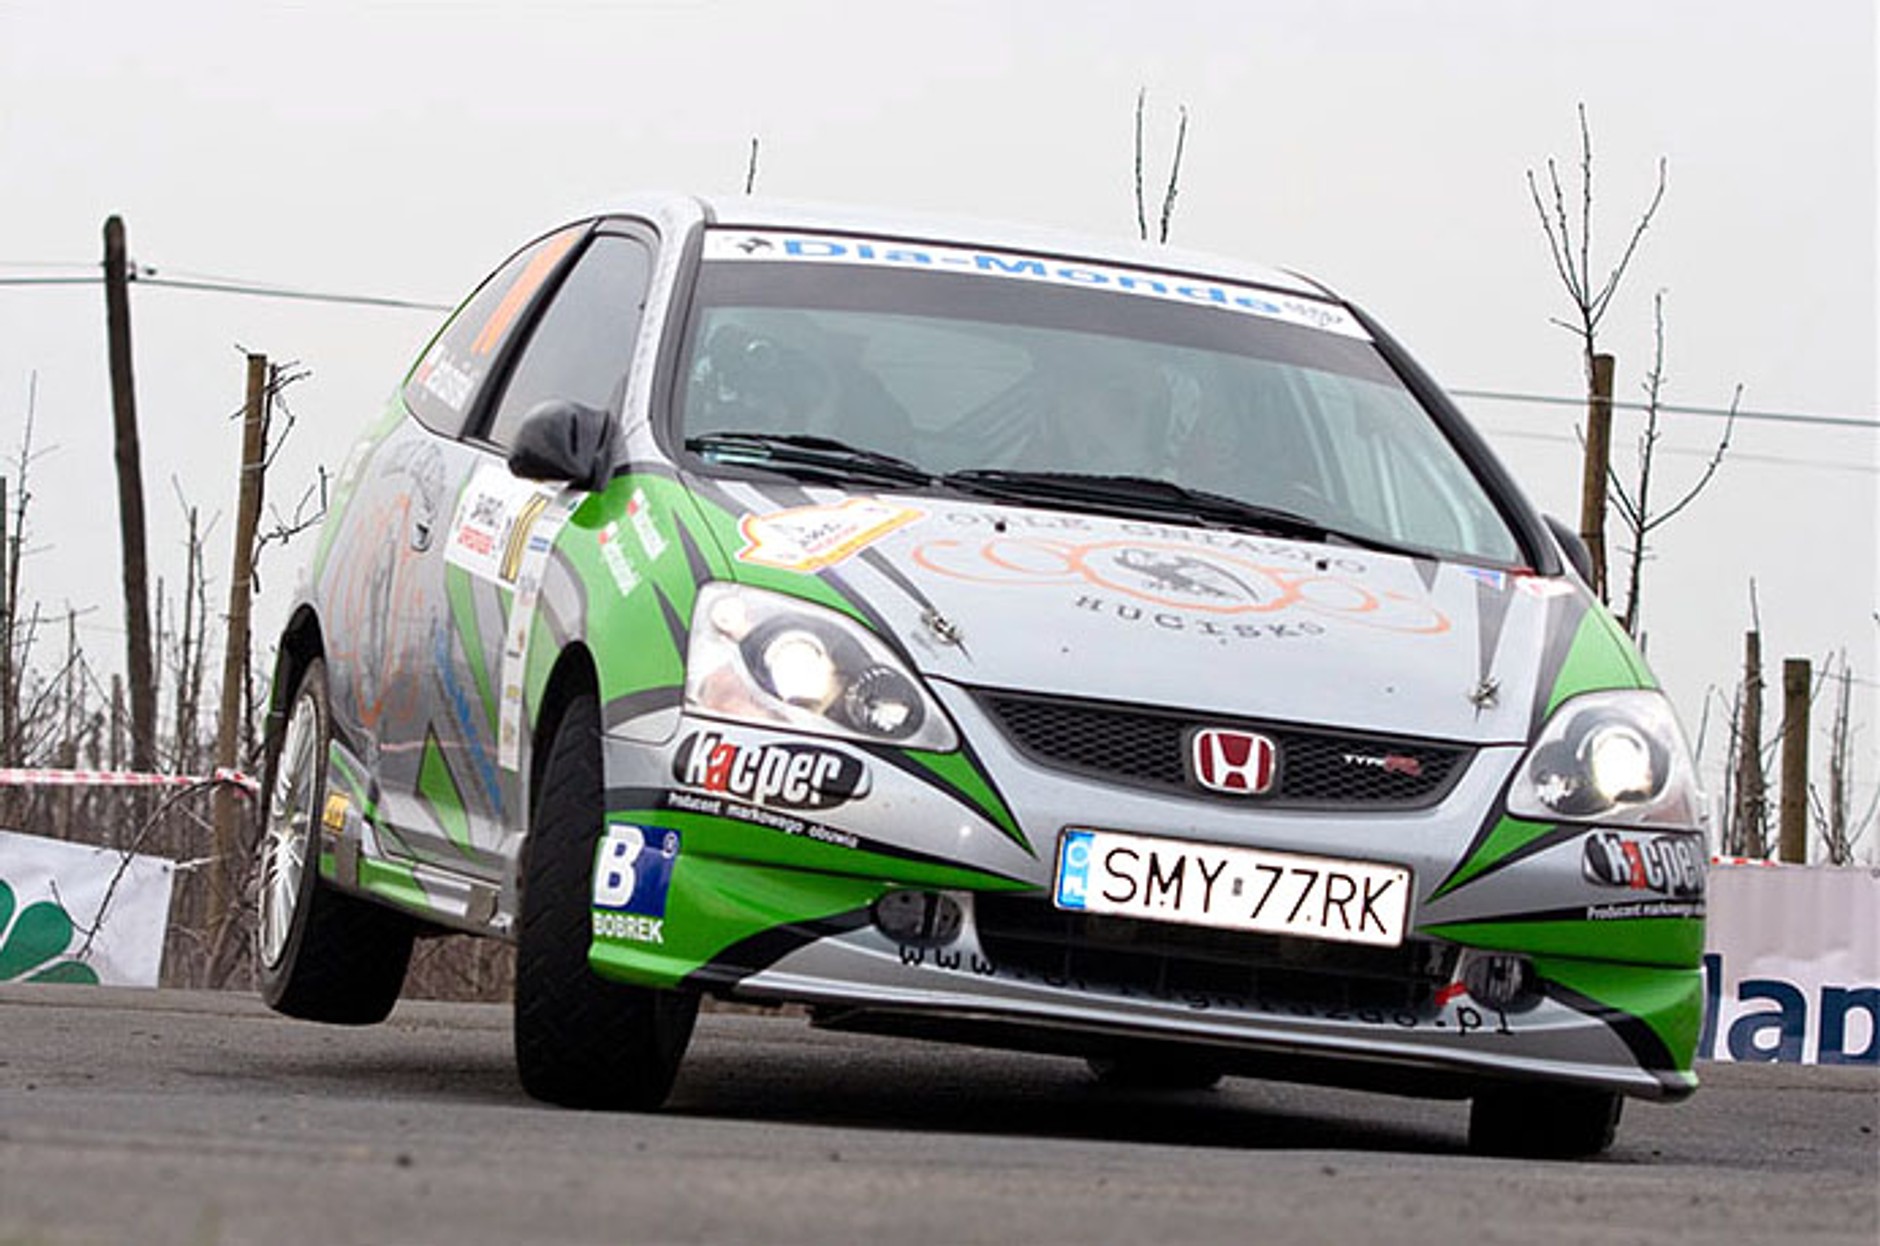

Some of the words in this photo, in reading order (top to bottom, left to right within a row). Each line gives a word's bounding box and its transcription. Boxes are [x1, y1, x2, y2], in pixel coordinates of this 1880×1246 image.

[1075, 595, 1326, 637] HUCISKO
[1102, 847, 1228, 914] SMY
[1249, 863, 1396, 936] 77RK
[592, 912, 665, 944] BOBREK
